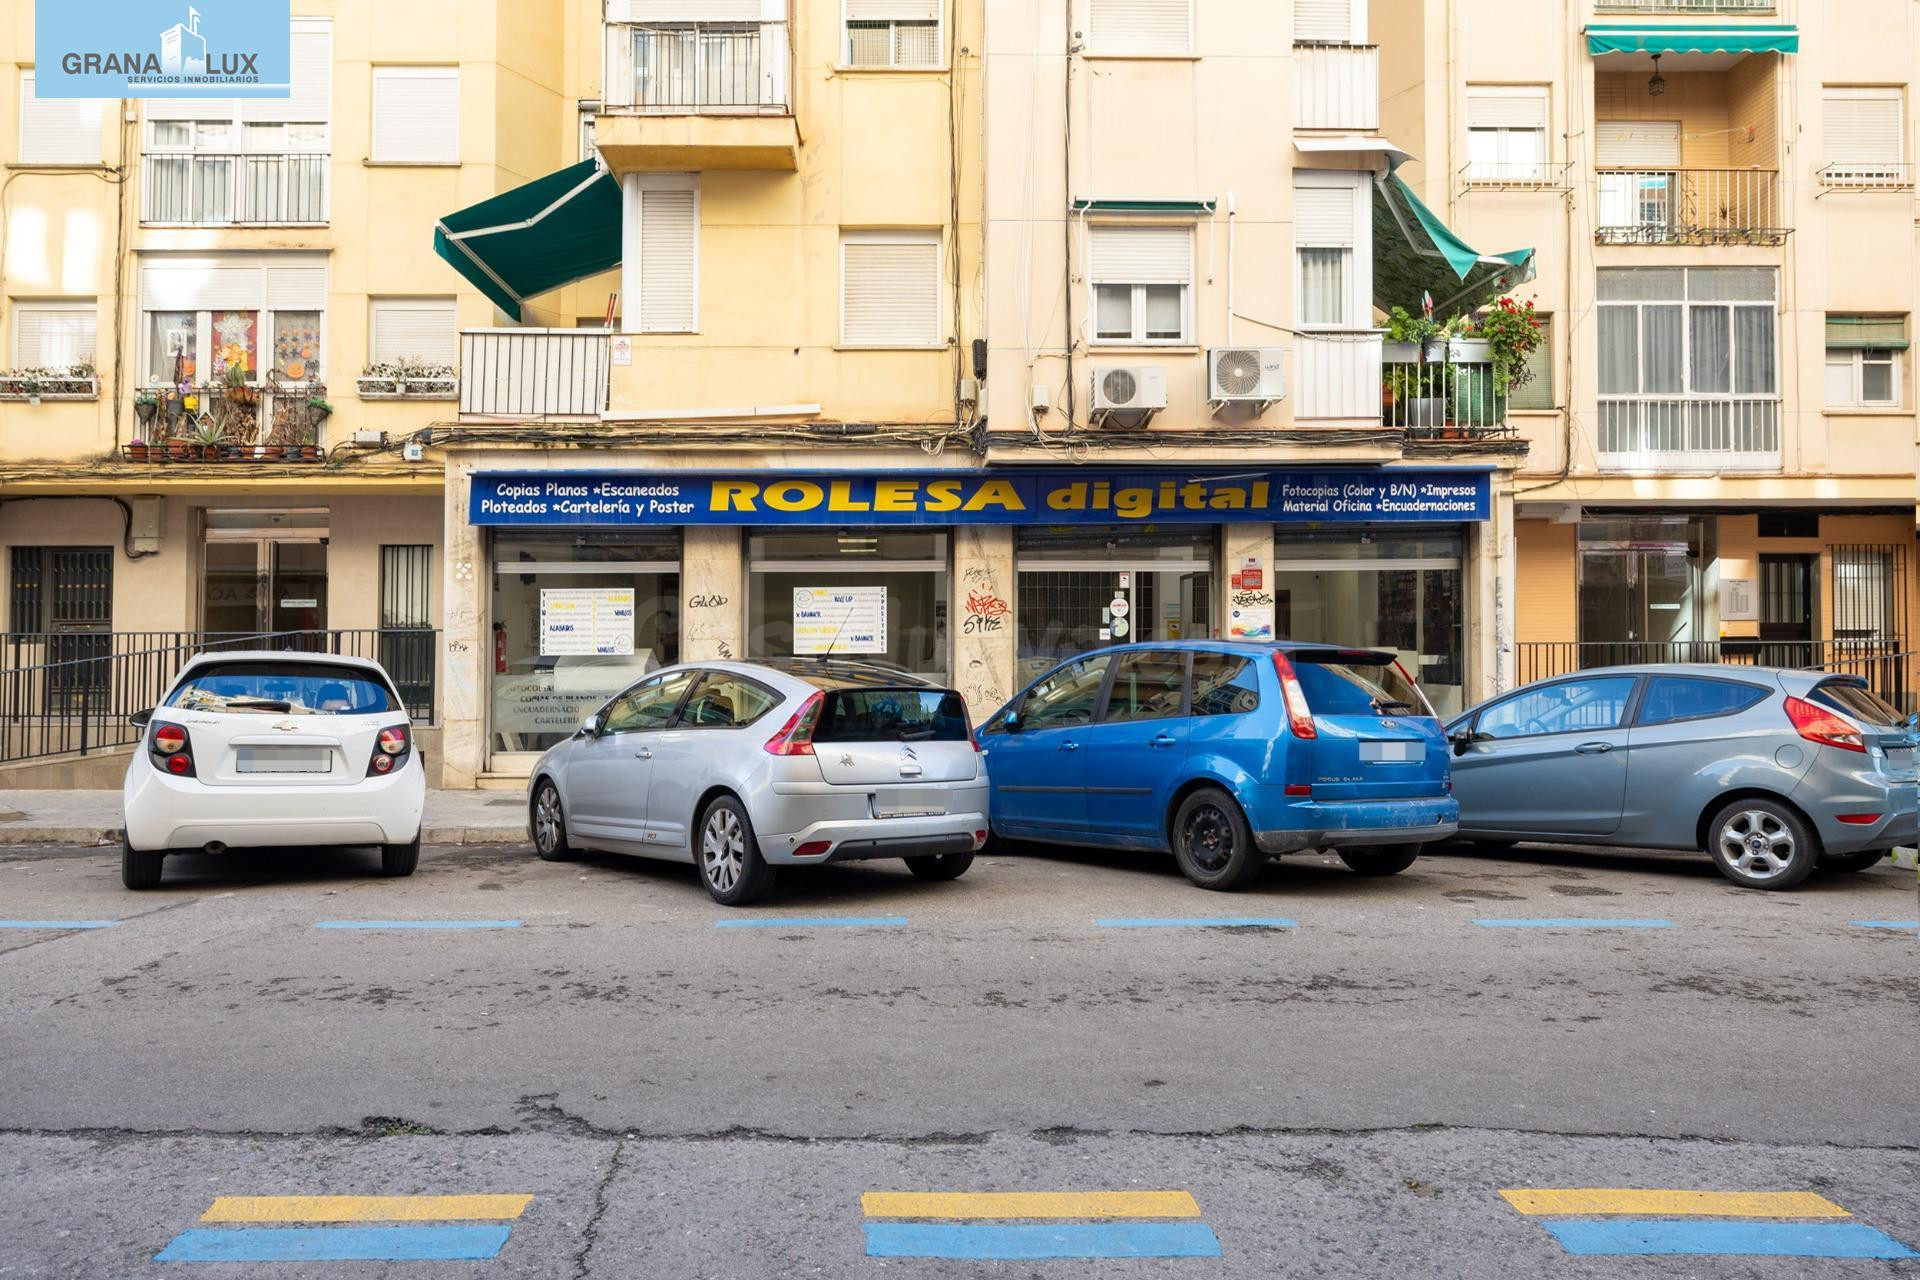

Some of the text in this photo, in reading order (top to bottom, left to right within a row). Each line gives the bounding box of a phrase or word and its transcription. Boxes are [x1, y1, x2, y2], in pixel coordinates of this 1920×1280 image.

[497, 483, 540, 500] Copias
[546, 483, 588, 497] Planos
[709, 481, 1027, 512] ROLESA
[1046, 481, 1270, 518] digital
[1282, 485, 1339, 500] Fotocopias
[1343, 484, 1375, 498] (Color
[1379, 487, 1386, 499] y
[1390, 484, 1417, 498] B/N)
[481, 500, 547, 514] Ploteados
[636, 504, 645, 517] y
[650, 500, 694, 514] Poster
[1283, 500, 1329, 512] Material
[1333, 499, 1372, 512] Oficina
